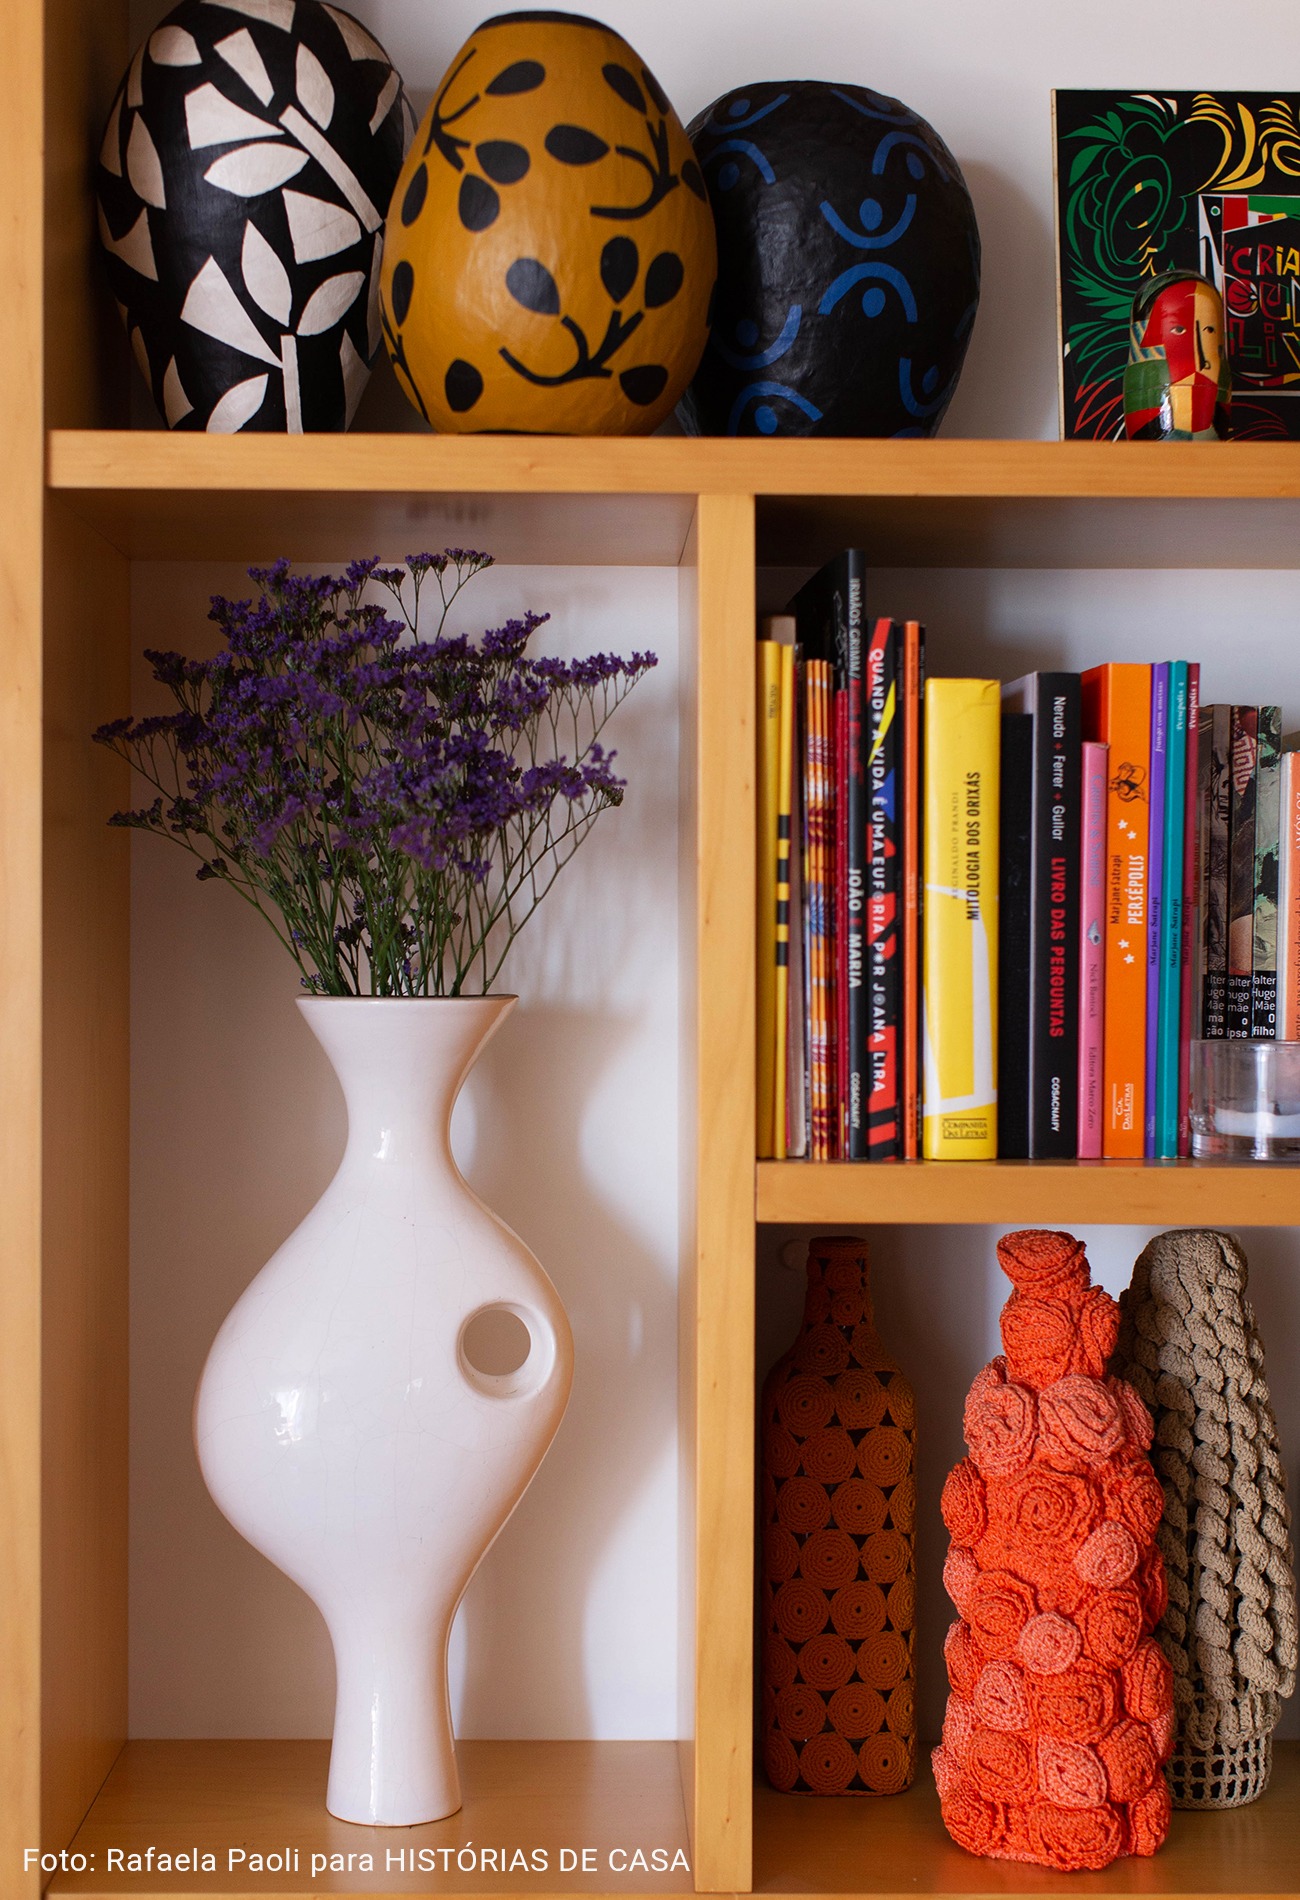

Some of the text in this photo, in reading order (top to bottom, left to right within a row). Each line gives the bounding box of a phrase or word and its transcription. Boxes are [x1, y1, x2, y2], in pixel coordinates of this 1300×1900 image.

[849, 578, 863, 626] IRMÃOS
[1053, 696, 1067, 738] Neruda
[872, 748, 885, 790] VIDA
[1052, 755, 1067, 789] Ferrer
[872, 796, 889, 807] É
[951, 791, 960, 833] PRANDI
[1051, 805, 1066, 841] Gullar
[872, 810, 886, 852] UMA
[963, 771, 980, 921] MITOLOGIA DOS ORIXÁS
[848, 868, 864, 912] JOÃO
[1051, 857, 1066, 903] LIVRO
[1110, 854, 1123, 925] Marjane Satrapi
[1124, 854, 1145, 925] PERSÉPOLIS
[1051, 908, 1065, 941] DAS
[848, 933, 863, 989] MARIA
[1050, 946, 1065, 1038] PERGUNTAS
[1088, 963, 1098, 1019] Nick Bantock
[1255, 1001, 1276, 1011] Mãe
[873, 1051, 886, 1092] LIRA
[1087, 1046, 1098, 1129] Editora Marco Zero
[1050, 1076, 1060, 1132] COSACNAIFY
